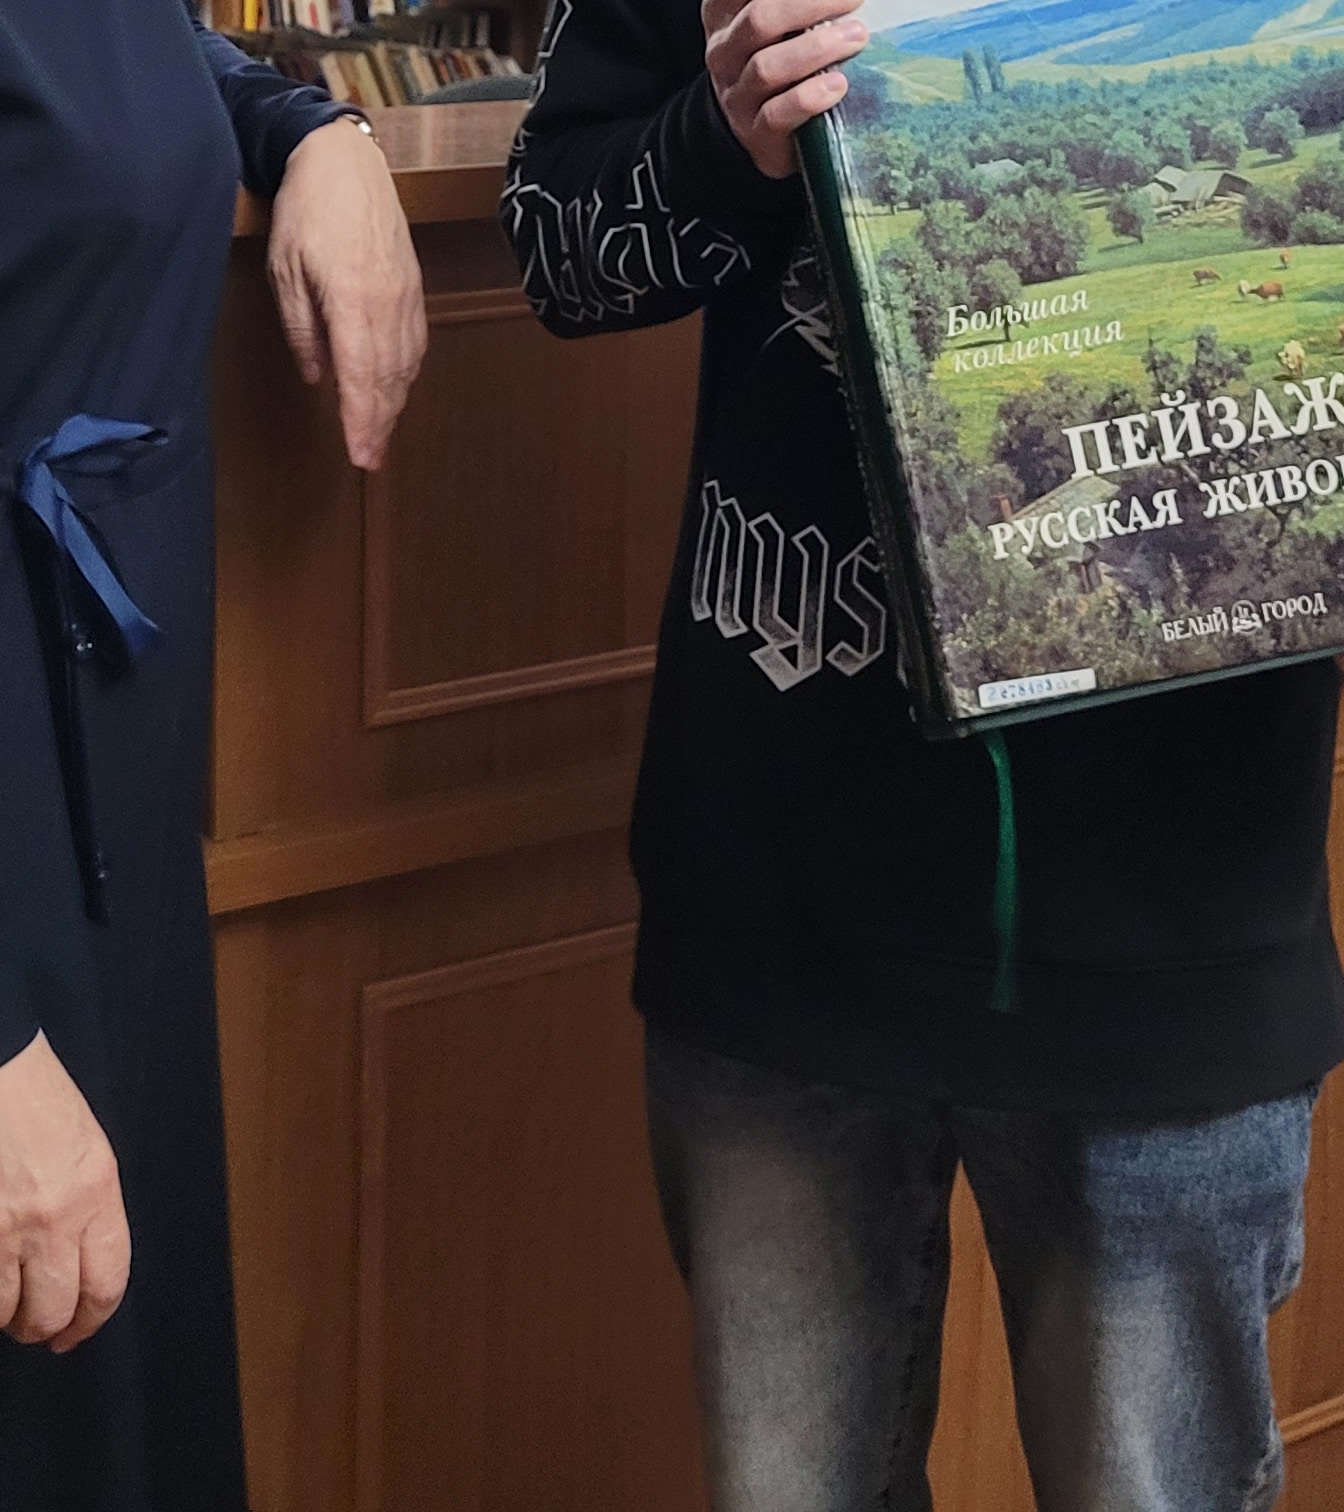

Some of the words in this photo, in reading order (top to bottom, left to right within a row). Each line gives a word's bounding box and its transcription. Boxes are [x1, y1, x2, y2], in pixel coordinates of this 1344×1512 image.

[946, 290, 1090, 337] Большая
[954, 320, 1124, 374] коллекция
[987, 488, 1184, 560] РУССКАЯ
[1161, 605, 1229, 643] БЕЛЫЙ
[1261, 592, 1329, 624] ГОРОД
